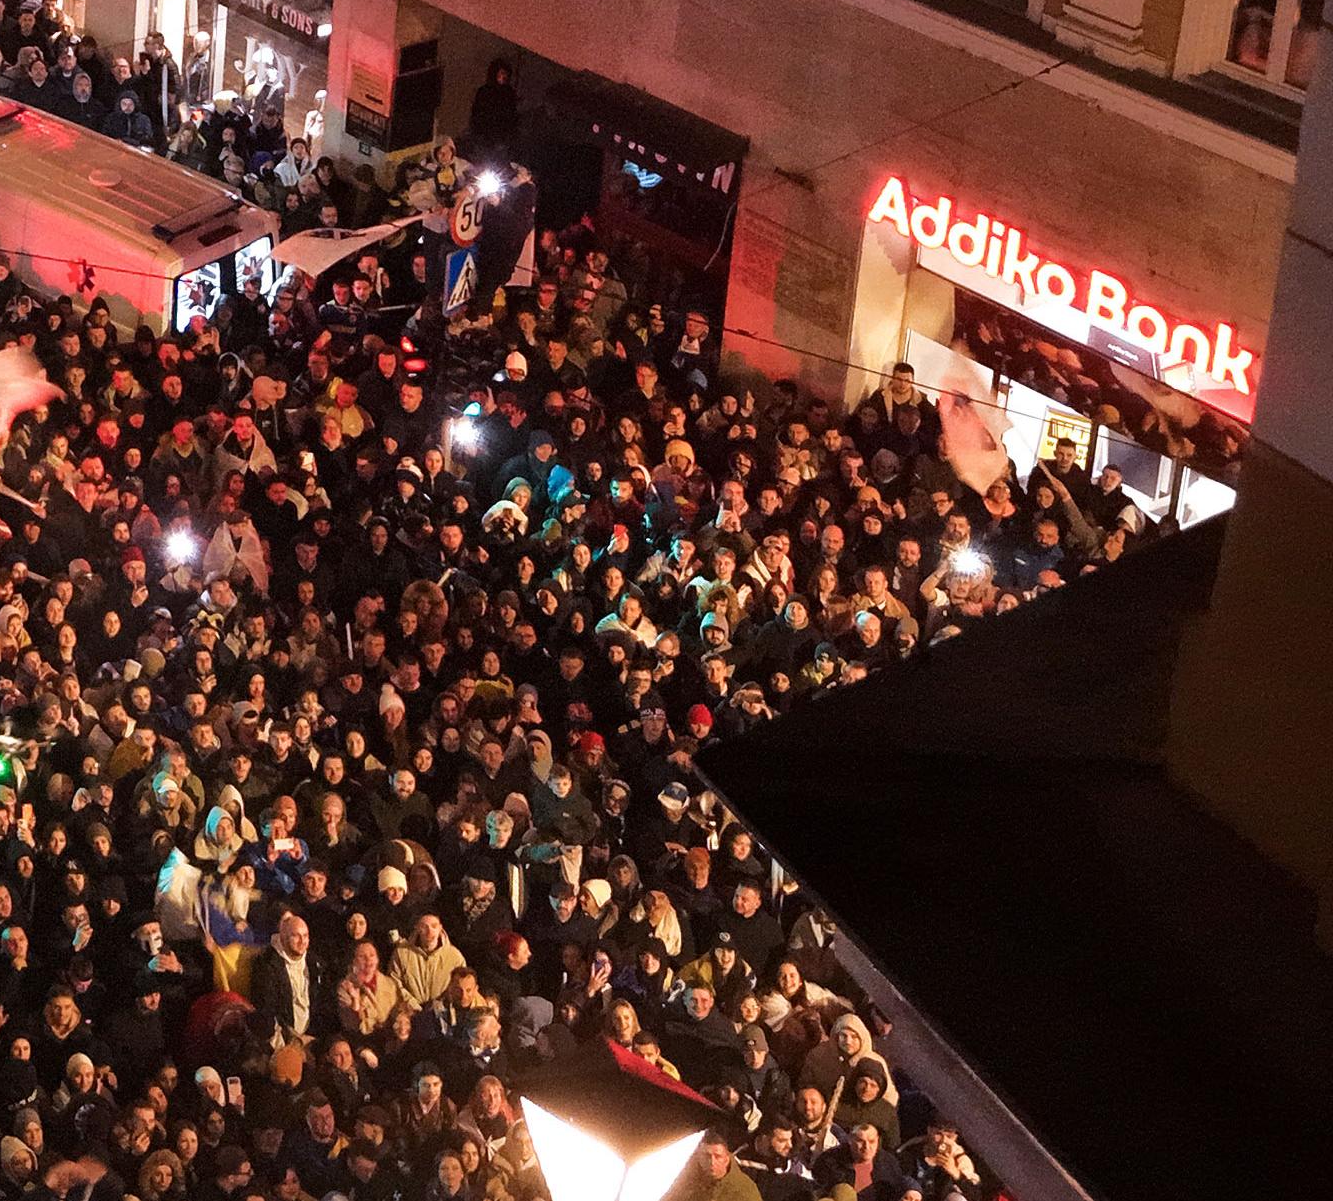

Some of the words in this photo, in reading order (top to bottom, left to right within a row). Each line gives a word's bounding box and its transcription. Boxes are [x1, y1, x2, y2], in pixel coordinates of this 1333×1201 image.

[271, 2, 279, 19] &
[281, 5, 313, 36] SONS
[868, 175, 1077, 307] Addiko
[1086, 269, 1253, 395] Bank
